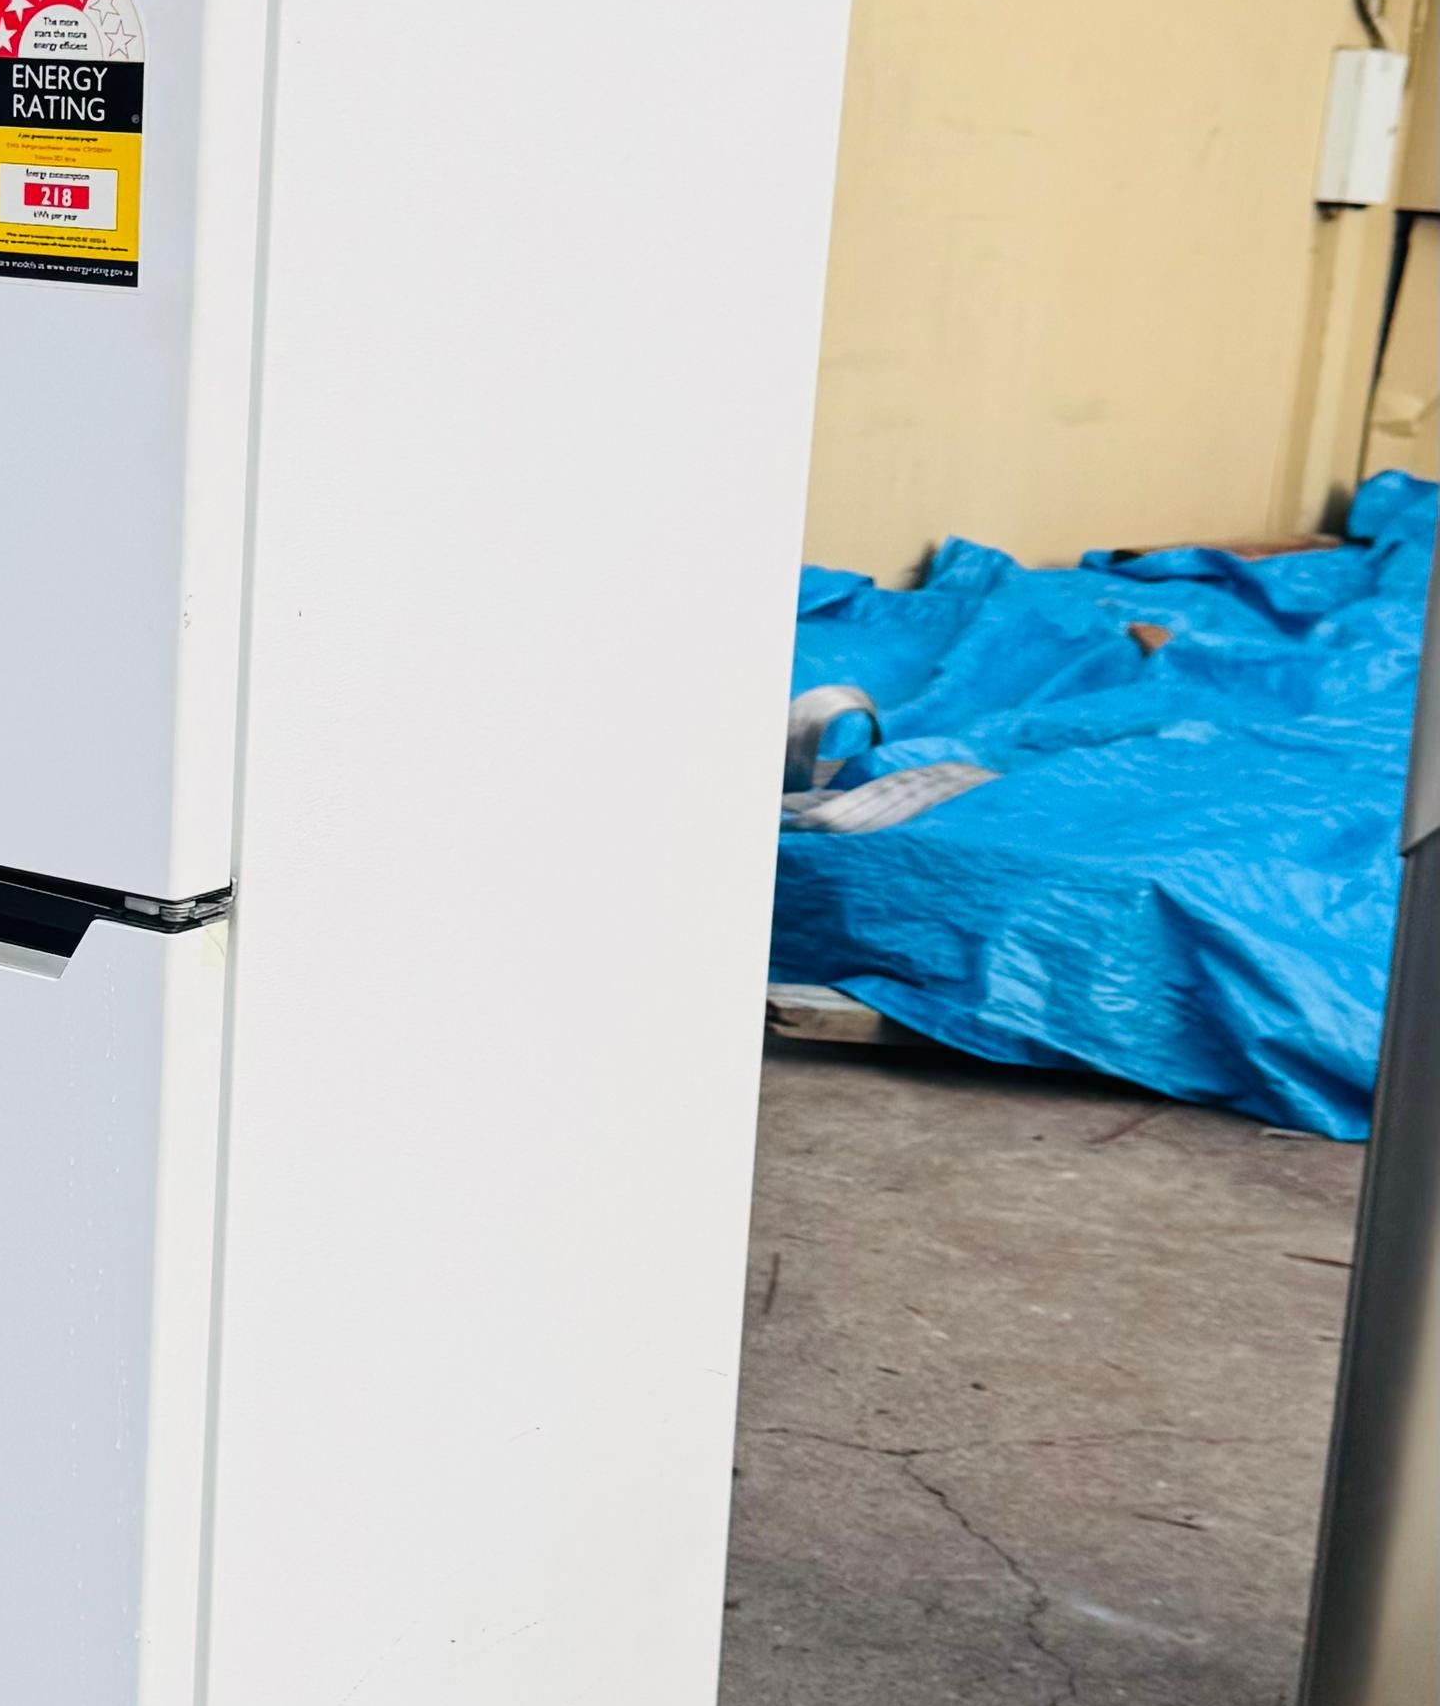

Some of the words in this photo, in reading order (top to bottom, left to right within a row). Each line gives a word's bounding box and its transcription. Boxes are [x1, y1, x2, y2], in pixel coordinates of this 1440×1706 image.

[12, 64, 108, 92] ENERGY
[12, 94, 106, 122] RATING
[41, 186, 72, 207] 218
